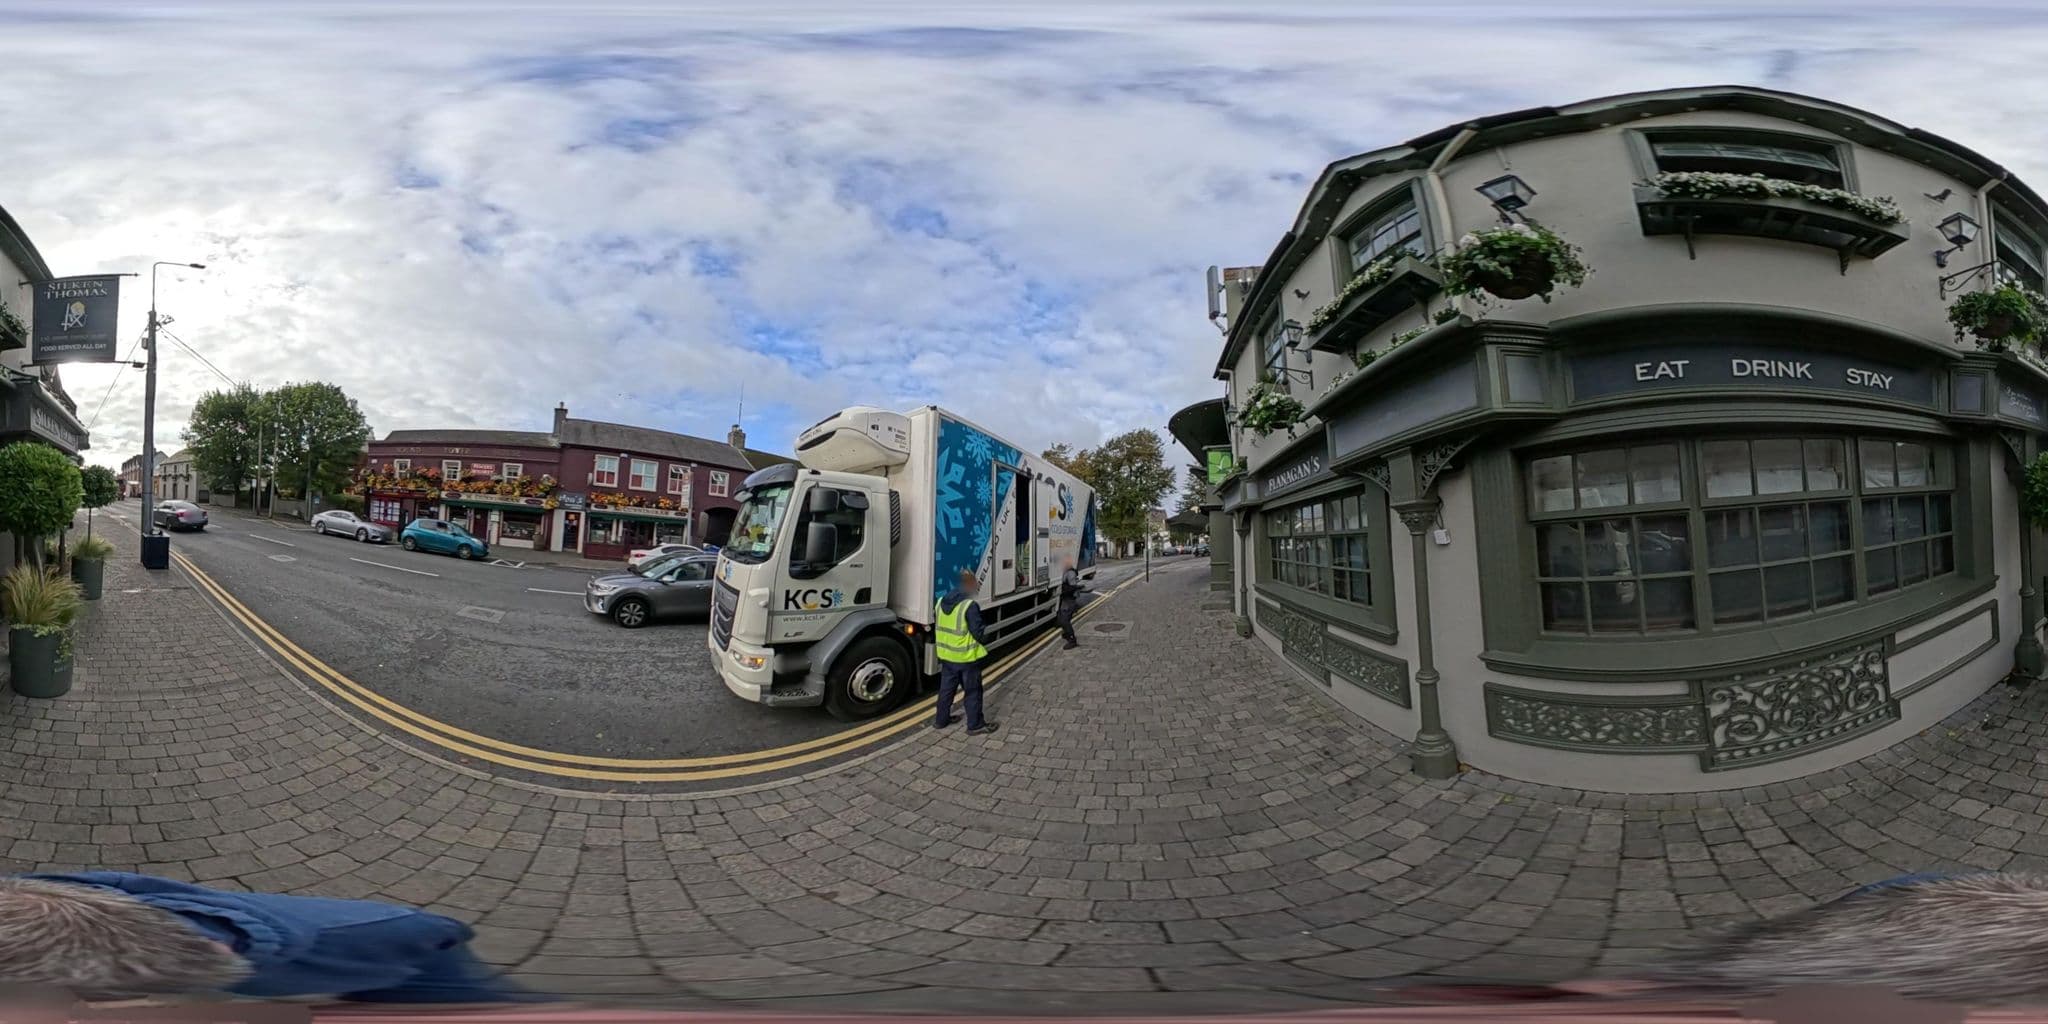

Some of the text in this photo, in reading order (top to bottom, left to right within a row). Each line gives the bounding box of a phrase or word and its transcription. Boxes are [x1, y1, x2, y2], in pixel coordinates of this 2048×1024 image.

[44, 287, 108, 299] THOMAS
[48, 280, 103, 290] SILKEN
[1635, 359, 1893, 390] EAT DRINK STAY
[1268, 455, 1320, 491] FLANAGAN'S
[784, 589, 833, 611] KCS
